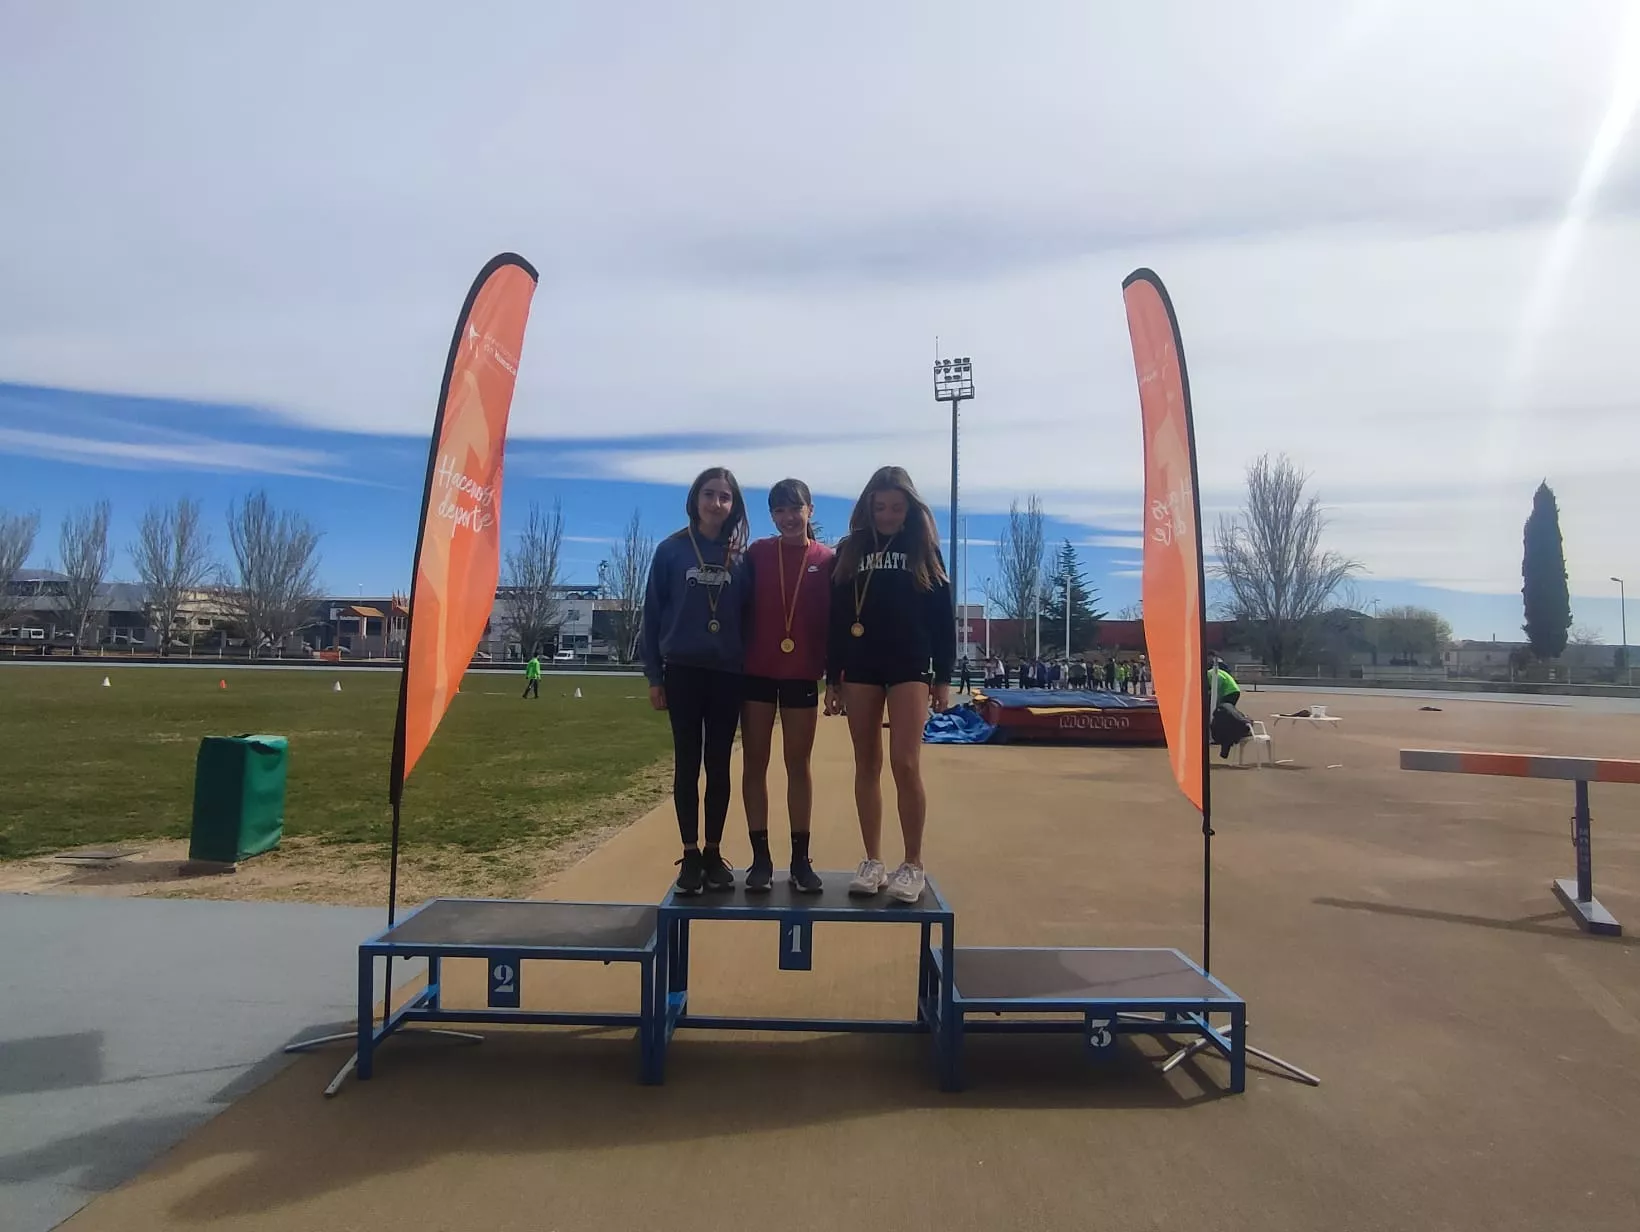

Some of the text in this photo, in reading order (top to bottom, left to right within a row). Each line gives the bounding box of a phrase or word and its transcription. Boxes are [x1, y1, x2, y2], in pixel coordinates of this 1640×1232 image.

[1059, 715, 1130, 729] MONDO
[788, 924, 801, 952] 1
[494, 965, 513, 992] 2
[1091, 1019, 1111, 1047] 3
